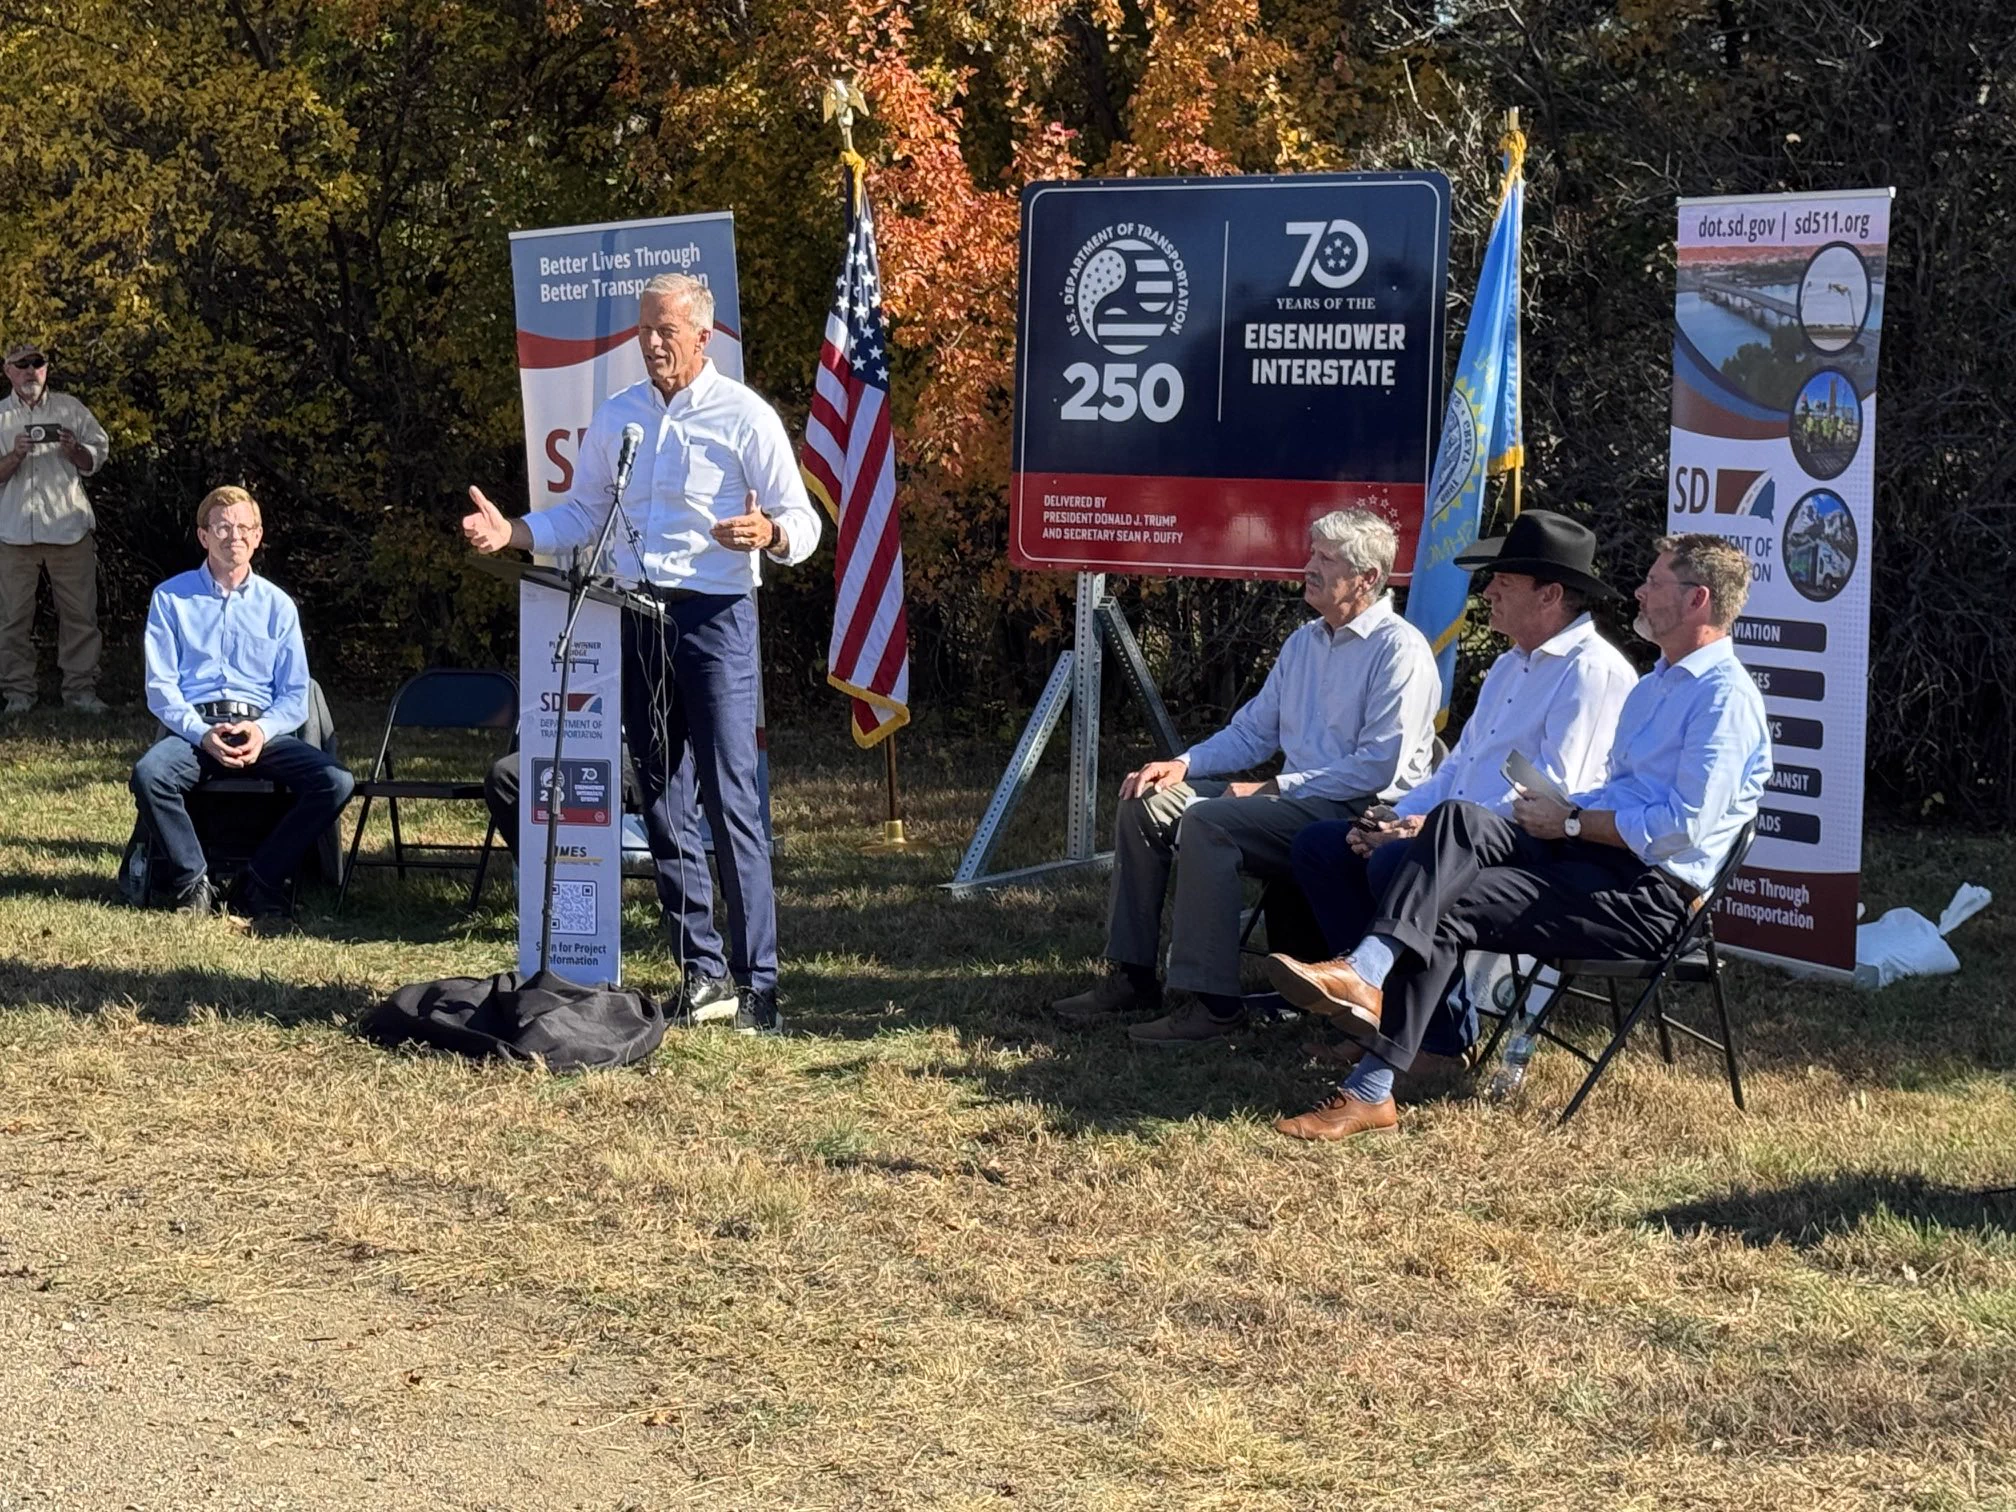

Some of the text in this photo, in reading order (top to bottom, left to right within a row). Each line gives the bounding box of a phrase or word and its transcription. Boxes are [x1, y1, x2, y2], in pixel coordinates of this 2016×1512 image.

[1698, 213, 1776, 242] dot.sd.gov
[1794, 210, 1870, 239] sd511.org
[539, 242, 700, 276] Better Lives Through
[1286, 219, 1369, 289] 70
[540, 270, 708, 303] Better Transpn
[1064, 223, 1189, 337] U.S. DEPARTMENT OF TRANSPORTATION
[1276, 298, 1376, 310] YEARS OF THE
[1245, 323, 1405, 350] EISENHOWER
[1252, 358, 1395, 386] INTERSTATE
[1061, 362, 1184, 423] 250
[1044, 495, 1107, 508] DELIVERED BY
[1674, 466, 1709, 514] SD
[1043, 511, 1177, 527] PRESIDENT DONALD J. TRUMP
[1042, 527, 1183, 544] AND SECRETARY SEAN P. DUFFY
[1755, 537, 1773, 557] OF
[1733, 622, 1781, 642] VIATION
[540, 719, 602, 729] DEPTMENT OF
[581, 768, 598, 780] 70
[555, 846, 587, 857] MES
[1759, 878, 1810, 908] Through
[1725, 897, 1814, 930] Transportation
[559, 942, 572, 952] for
[574, 943, 607, 956] Project
